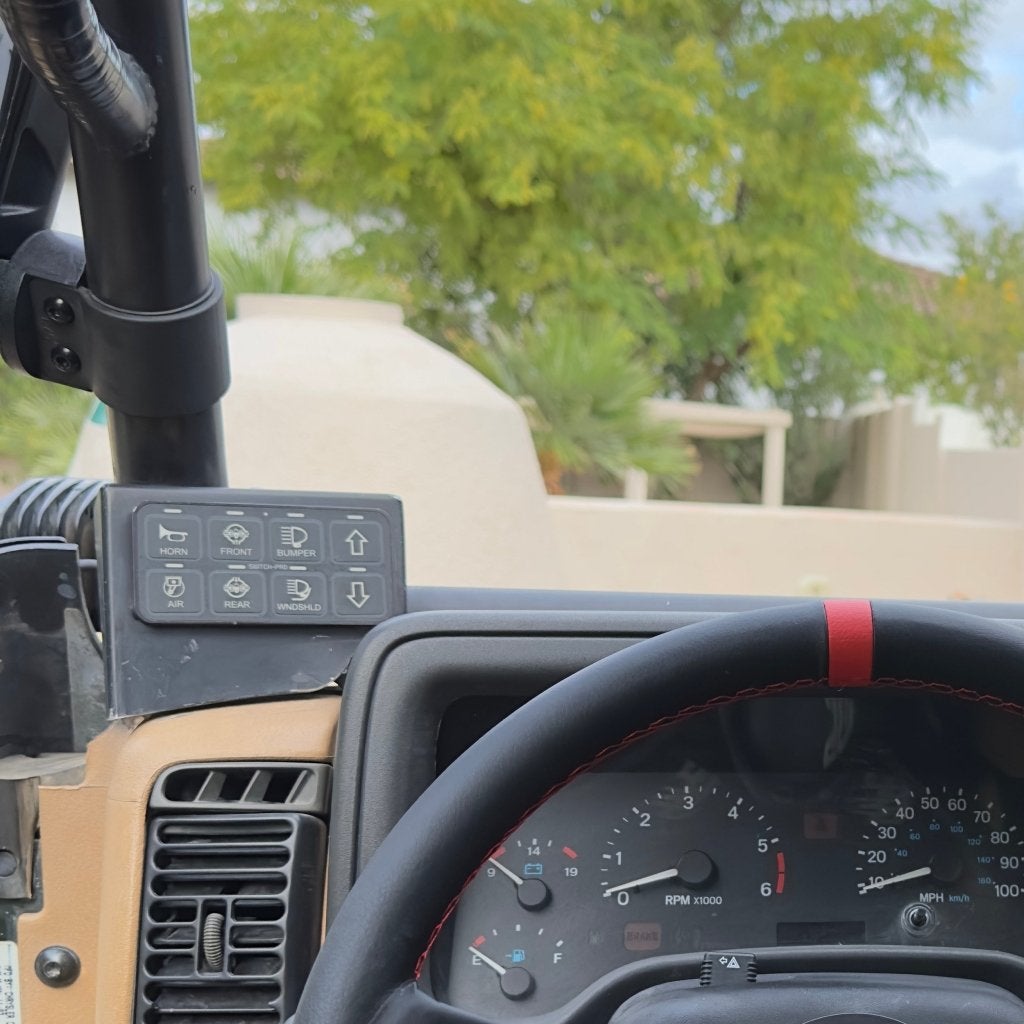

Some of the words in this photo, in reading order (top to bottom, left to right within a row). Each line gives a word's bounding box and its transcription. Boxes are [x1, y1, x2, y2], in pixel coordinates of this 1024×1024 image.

[160, 548, 188, 556] HORN
[220, 548, 252, 556] FRONT
[277, 549, 316, 558] BUMPER
[167, 600, 184, 608] AIR
[224, 600, 250, 609] REAR
[277, 603, 322, 612] WNDSHLD
[683, 796, 694, 810] 3
[921, 796, 940, 810] 50
[948, 798, 967, 812] 60
[727, 806, 739, 819] 4
[895, 807, 914, 820] 40
[974, 810, 991, 823] 70
[639, 813, 651, 827] 2
[878, 827, 896, 840] 30
[950, 825, 964, 833] 100
[990, 831, 1010, 845] 80
[527, 846, 541, 856] 14
[758, 839, 768, 853] 5
[616, 851, 622, 866] 1
[867, 850, 887, 864] 20
[897, 849, 908, 857] 40
[1000, 856, 1019, 869] 90
[487, 867, 496, 878] 9
[564, 867, 578, 878] 19
[868, 876, 885, 890] 10
[760, 883, 772, 897] 6
[994, 884, 1020, 898] 100
[617, 891, 629, 906] 0
[665, 895, 690, 906] RPM
[919, 893, 944, 903] MPH
[948, 893, 970, 903] km/h
[472, 955, 482, 966] E
[553, 953, 562, 964] F
